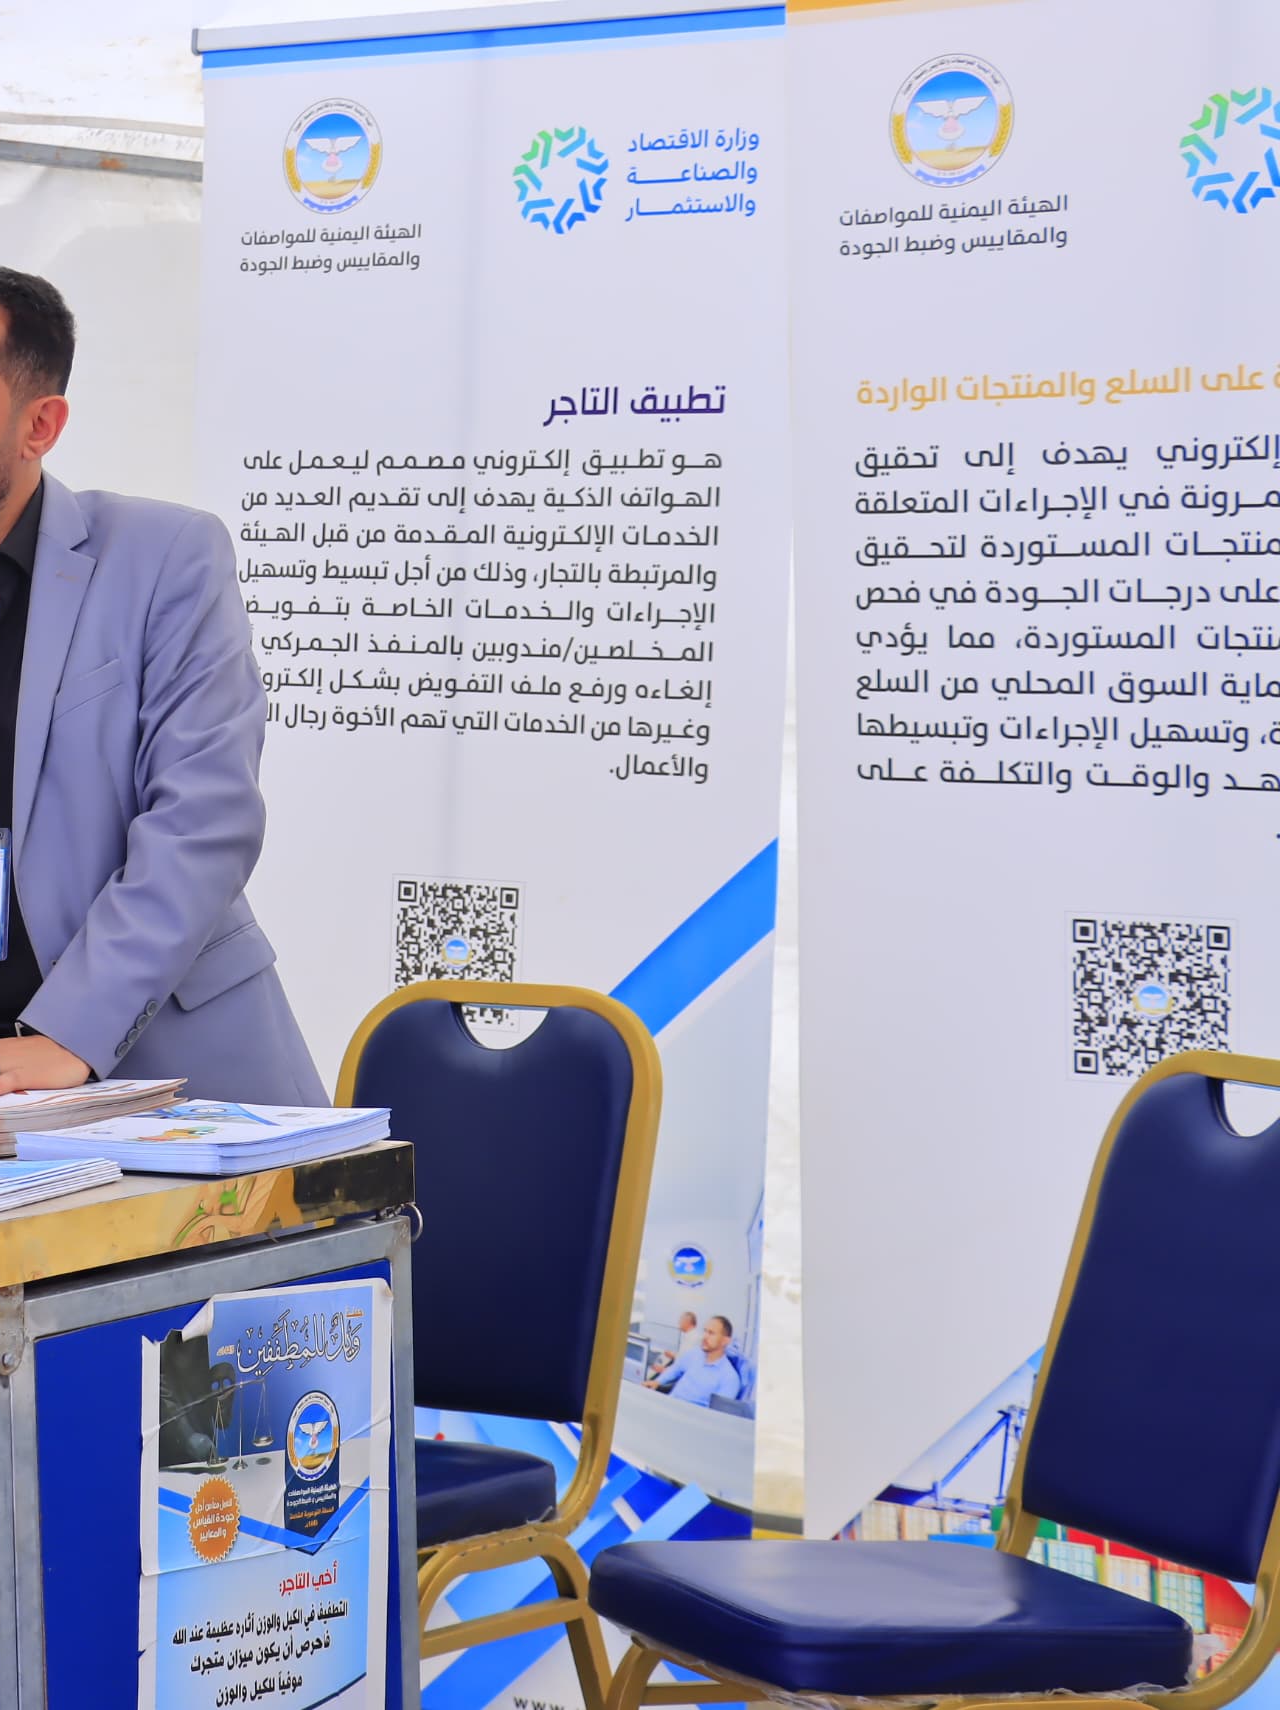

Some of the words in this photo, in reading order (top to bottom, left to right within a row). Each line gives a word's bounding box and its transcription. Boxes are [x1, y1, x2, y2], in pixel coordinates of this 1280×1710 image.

[628, 129, 708, 152] الاقتصاد
[715, 128, 759, 152] وزارة
[627, 160, 758, 184] والصناعة
[625, 193, 756, 222] والاستثمار
[840, 204, 933, 228] للمواصفات
[939, 200, 1001, 223] اليمنية
[1008, 194, 1067, 218] الهيئة
[241, 228, 316, 248] للمواصفات
[320, 226, 369, 245] اليمنية
[374, 224, 421, 243] الهيئة
[904, 234, 955, 255] وضبط
[962, 226, 1067, 253] والمقاييس
[337, 251, 420, 272] والمقاييس
[840, 237, 898, 260] الجودة
[240, 256, 288, 276] الجودة
[291, 255, 332, 273] وضبط
[956, 372, 1096, 406] والمنتجات
[1105, 367, 1191, 404] السلع
[1201, 364, 1264, 392] على
[543, 386, 618, 427] التاجر
[630, 385, 726, 423] تطبيق
[857, 376, 947, 412] الواردة
[244, 450, 283, 469] على
[289, 449, 369, 475] ليعمل
[376, 456, 465, 476] مصمم
[473, 449, 570, 476] إلكتروني
[582, 448, 665, 476] تطبيق
[672, 453, 722, 476] هو
[855, 445, 939, 478] تحقيق
[965, 442, 1016, 475] إلى
[1042, 441, 1127, 470] يهدف
[242, 492, 267, 511] من
[275, 486, 341, 511] العديد
[349, 487, 421, 512] تقديم
[428, 486, 466, 514] إلى
[474, 487, 535, 512] يهدف
[544, 486, 612, 512] الذكية
[621, 486, 720, 514] الهواتف
[855, 489, 968, 514] المتعلقة
[979, 486, 1107, 520] الإجراءات
[1119, 485, 1170, 517] في
[240, 520, 305, 542] الهيئة
[313, 522, 348, 548] قبل
[356, 529, 386, 549] من
[394, 524, 495, 544] المقدمة
[504, 524, 614, 552] الإلكترونية
[622, 525, 718, 546] الخدمات
[856, 534, 966, 567] لتحقيق
[981, 531, 1150, 566] المستوردة
[239, 558, 317, 585] وتسهيل
[322, 559, 389, 580] تبسيط
[395, 554, 431, 586] أجل
[437, 567, 466, 587] من
[473, 561, 526, 589] وذلك
[533, 562, 601, 589] بالتجار،
[608, 563, 717, 592] والمرتبطة
[362, 597, 452, 617] الخاصة
[856, 580, 920, 610] فحص
[929, 580, 976, 610] في
[985, 578, 1099, 611] الجودة
[1109, 578, 1211, 611] درجات
[465, 599, 594, 628] والخدمات
[607, 601, 715, 631] الإجراءات
[261, 631, 358, 657] الجمركي
[368, 634, 463, 661] بالمنفذ
[856, 622, 927, 656] يؤدي
[949, 624, 995, 648] مما
[1016, 624, 1175, 657] المستوردة،
[263, 668, 322, 694] إلكترو
[330, 667, 400, 696] بشكل
[408, 673, 503, 699] التفويض
[511, 675, 561, 695] ملف
[568, 682, 627, 705] ورفع
[635, 679, 711, 708] إلغاءه
[856, 668, 928, 700] السلع
[941, 677, 978, 701] من
[991, 670, 1094, 701] المحلي
[1108, 672, 1207, 704] السوق
[285, 704, 326, 731] رجال
[332, 704, 394, 731] الأخوة
[401, 710, 447, 734] تهم
[452, 710, 498, 735] التي
[504, 712, 585, 734] الخدمات
[858, 712, 988, 747] وتبسيطها
[591, 721, 621, 741] من
[628, 716, 710, 746] وغيرها
[1000, 716, 1118, 749] الإجراءات
[1130, 717, 1249, 752] وتسهيل
[610, 754, 708, 784] والأعمال.
[857, 757, 928, 782] على
[940, 760, 1072, 794] والتكلفة
[1086, 763, 1209, 797] والوقت
[279, 1572, 309, 1596] التاجر:
[312, 1561, 338, 1591] أخي
[256, 1613, 281, 1636] والوزن
[282, 1610, 302, 1632] الكيل
[304, 1605, 315, 1629] في
[173, 1628, 186, 1645] الله
[189, 1626, 204, 1643] عند
[190, 1651, 225, 1675] متجرك
[227, 1644, 253, 1669] ميزان
[256, 1644, 280, 1664] يكون
